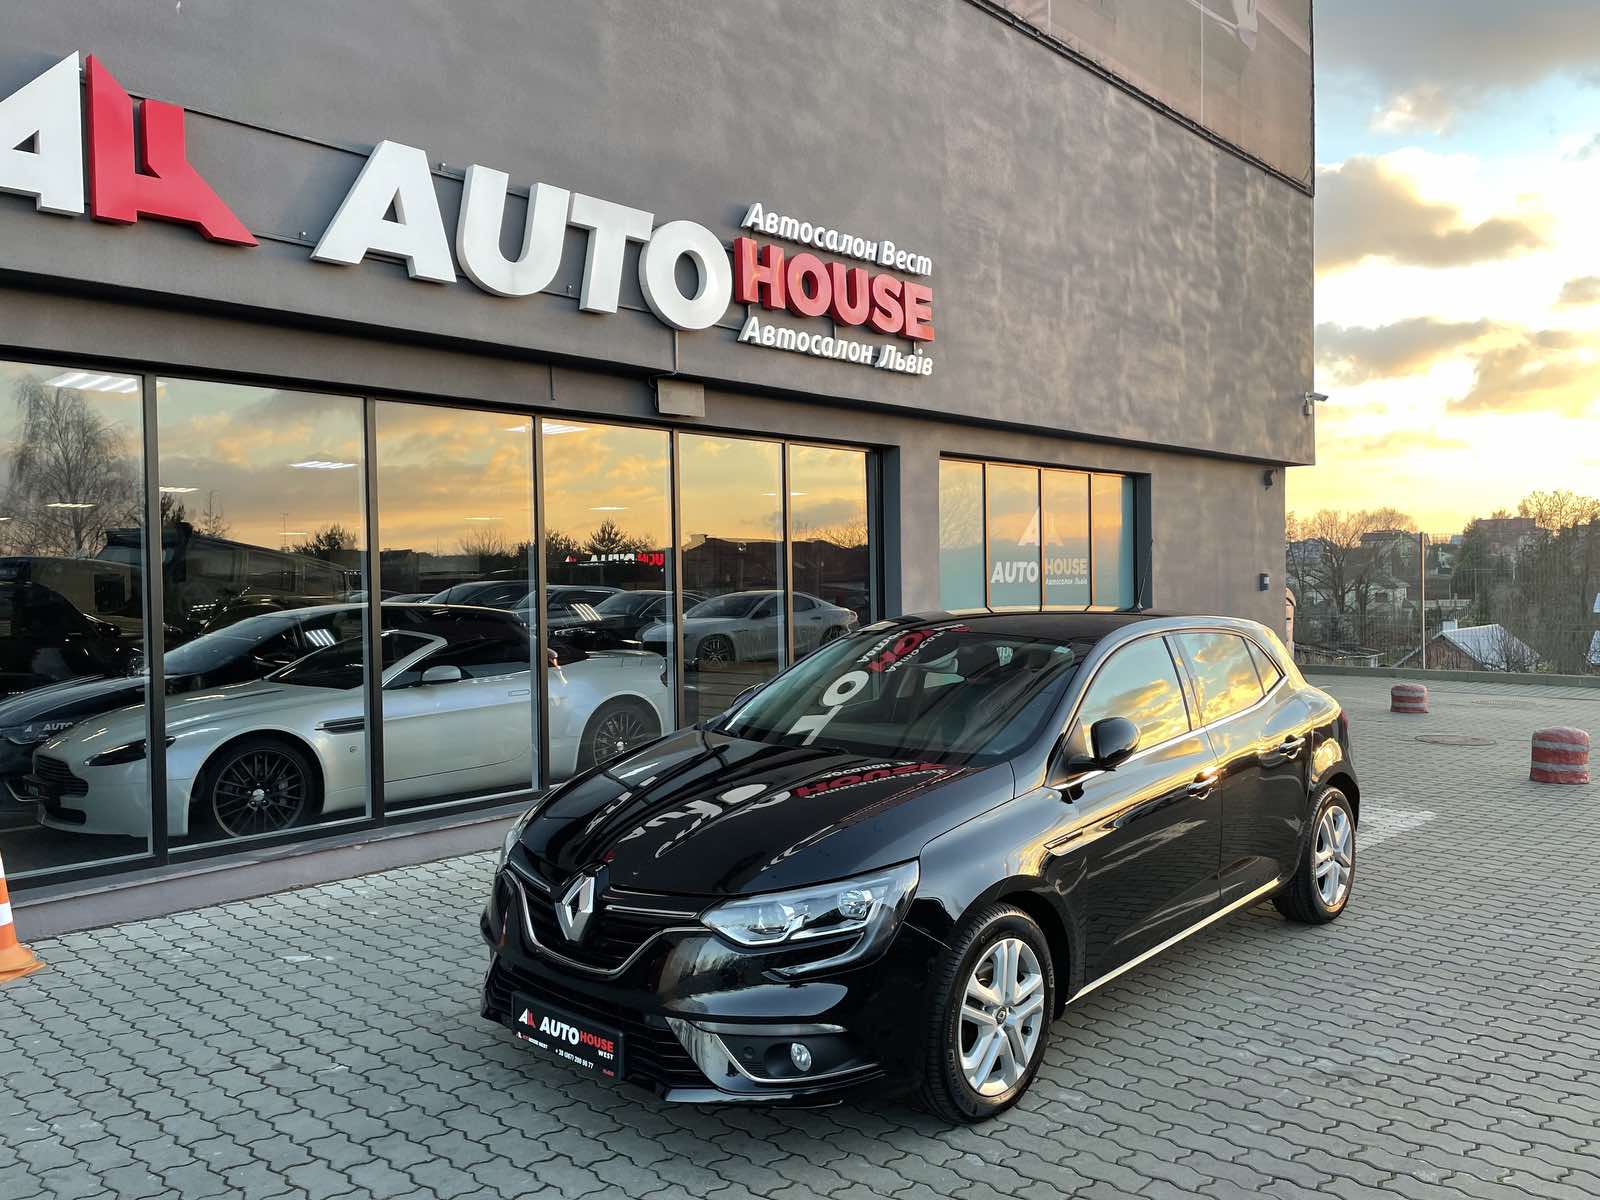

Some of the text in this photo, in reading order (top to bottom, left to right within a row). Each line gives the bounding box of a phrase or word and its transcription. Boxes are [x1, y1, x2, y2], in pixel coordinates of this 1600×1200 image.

[310, 139, 935, 342] AUTO HOUSE
[741, 202, 933, 276] Автосалон Вест
[737, 316, 934, 377] Автосалон Львів
[991, 558, 1088, 584] AUTO HOUSE
[539, 1016, 580, 1046] AUTO
[580, 1031, 614, 1053] HOUSE
[597, 1049, 614, 1061] WEST
